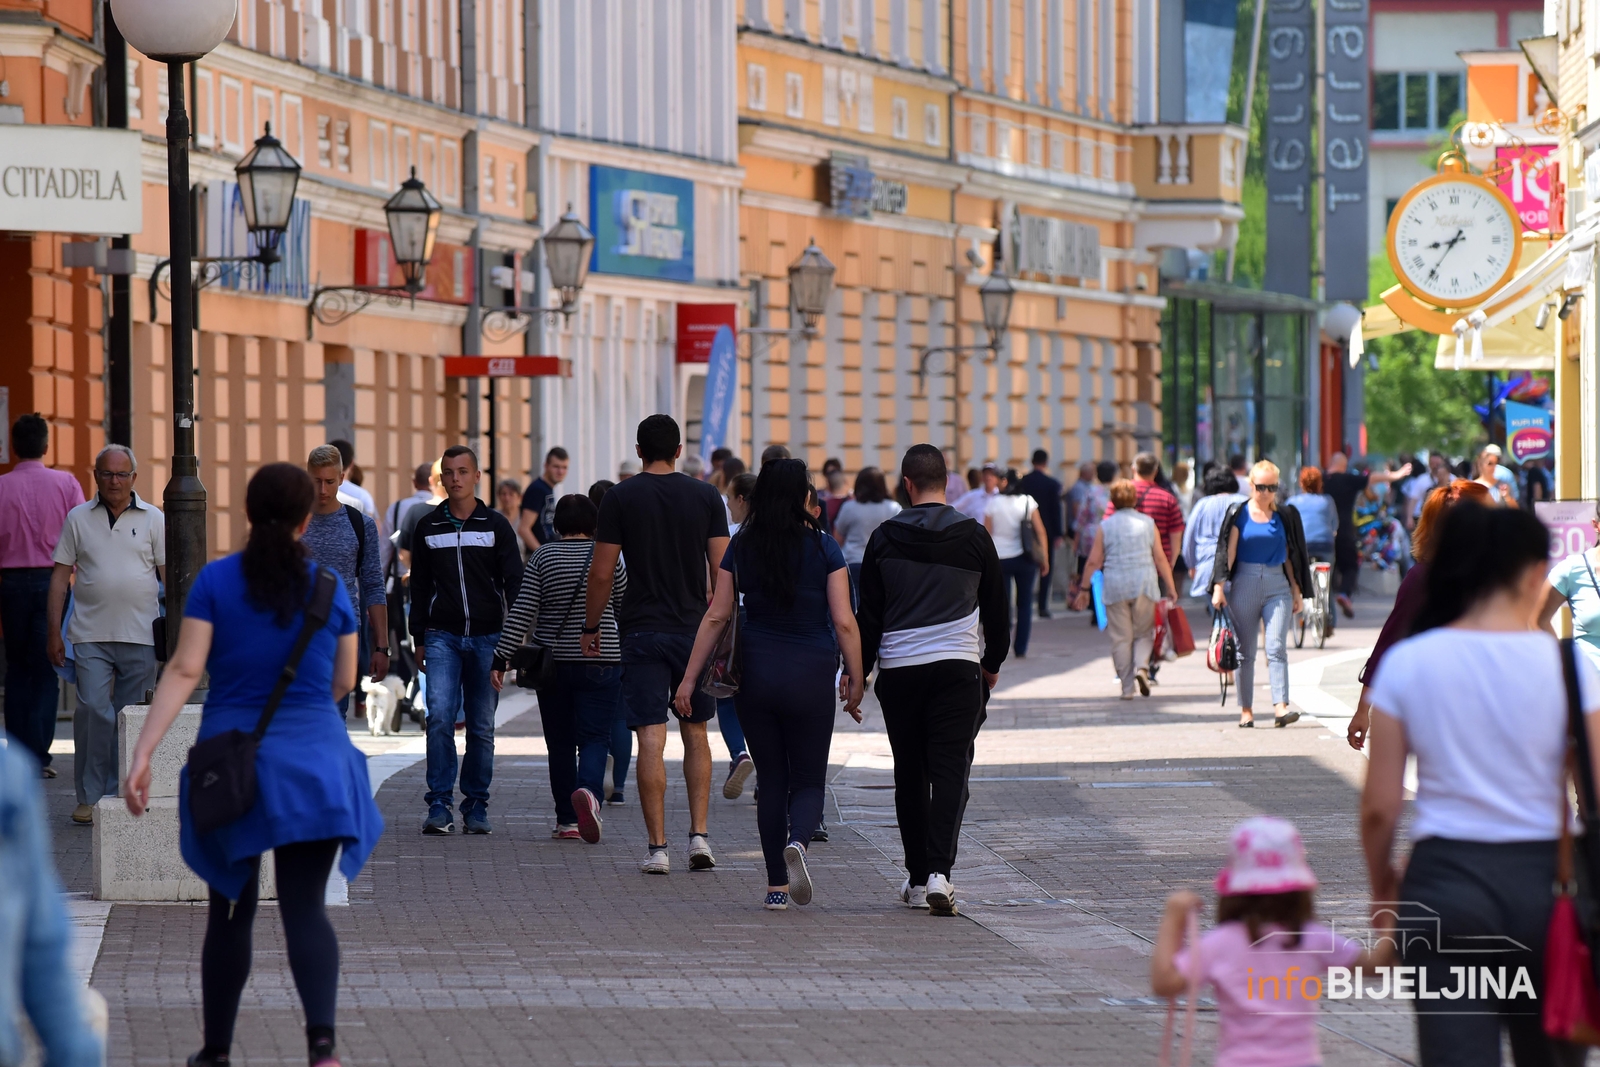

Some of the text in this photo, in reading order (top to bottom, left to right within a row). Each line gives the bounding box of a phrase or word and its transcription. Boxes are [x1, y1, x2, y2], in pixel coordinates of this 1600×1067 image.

[2, 165, 128, 201] CITADELA
[1511, 417, 1544, 427] KUPI ME
